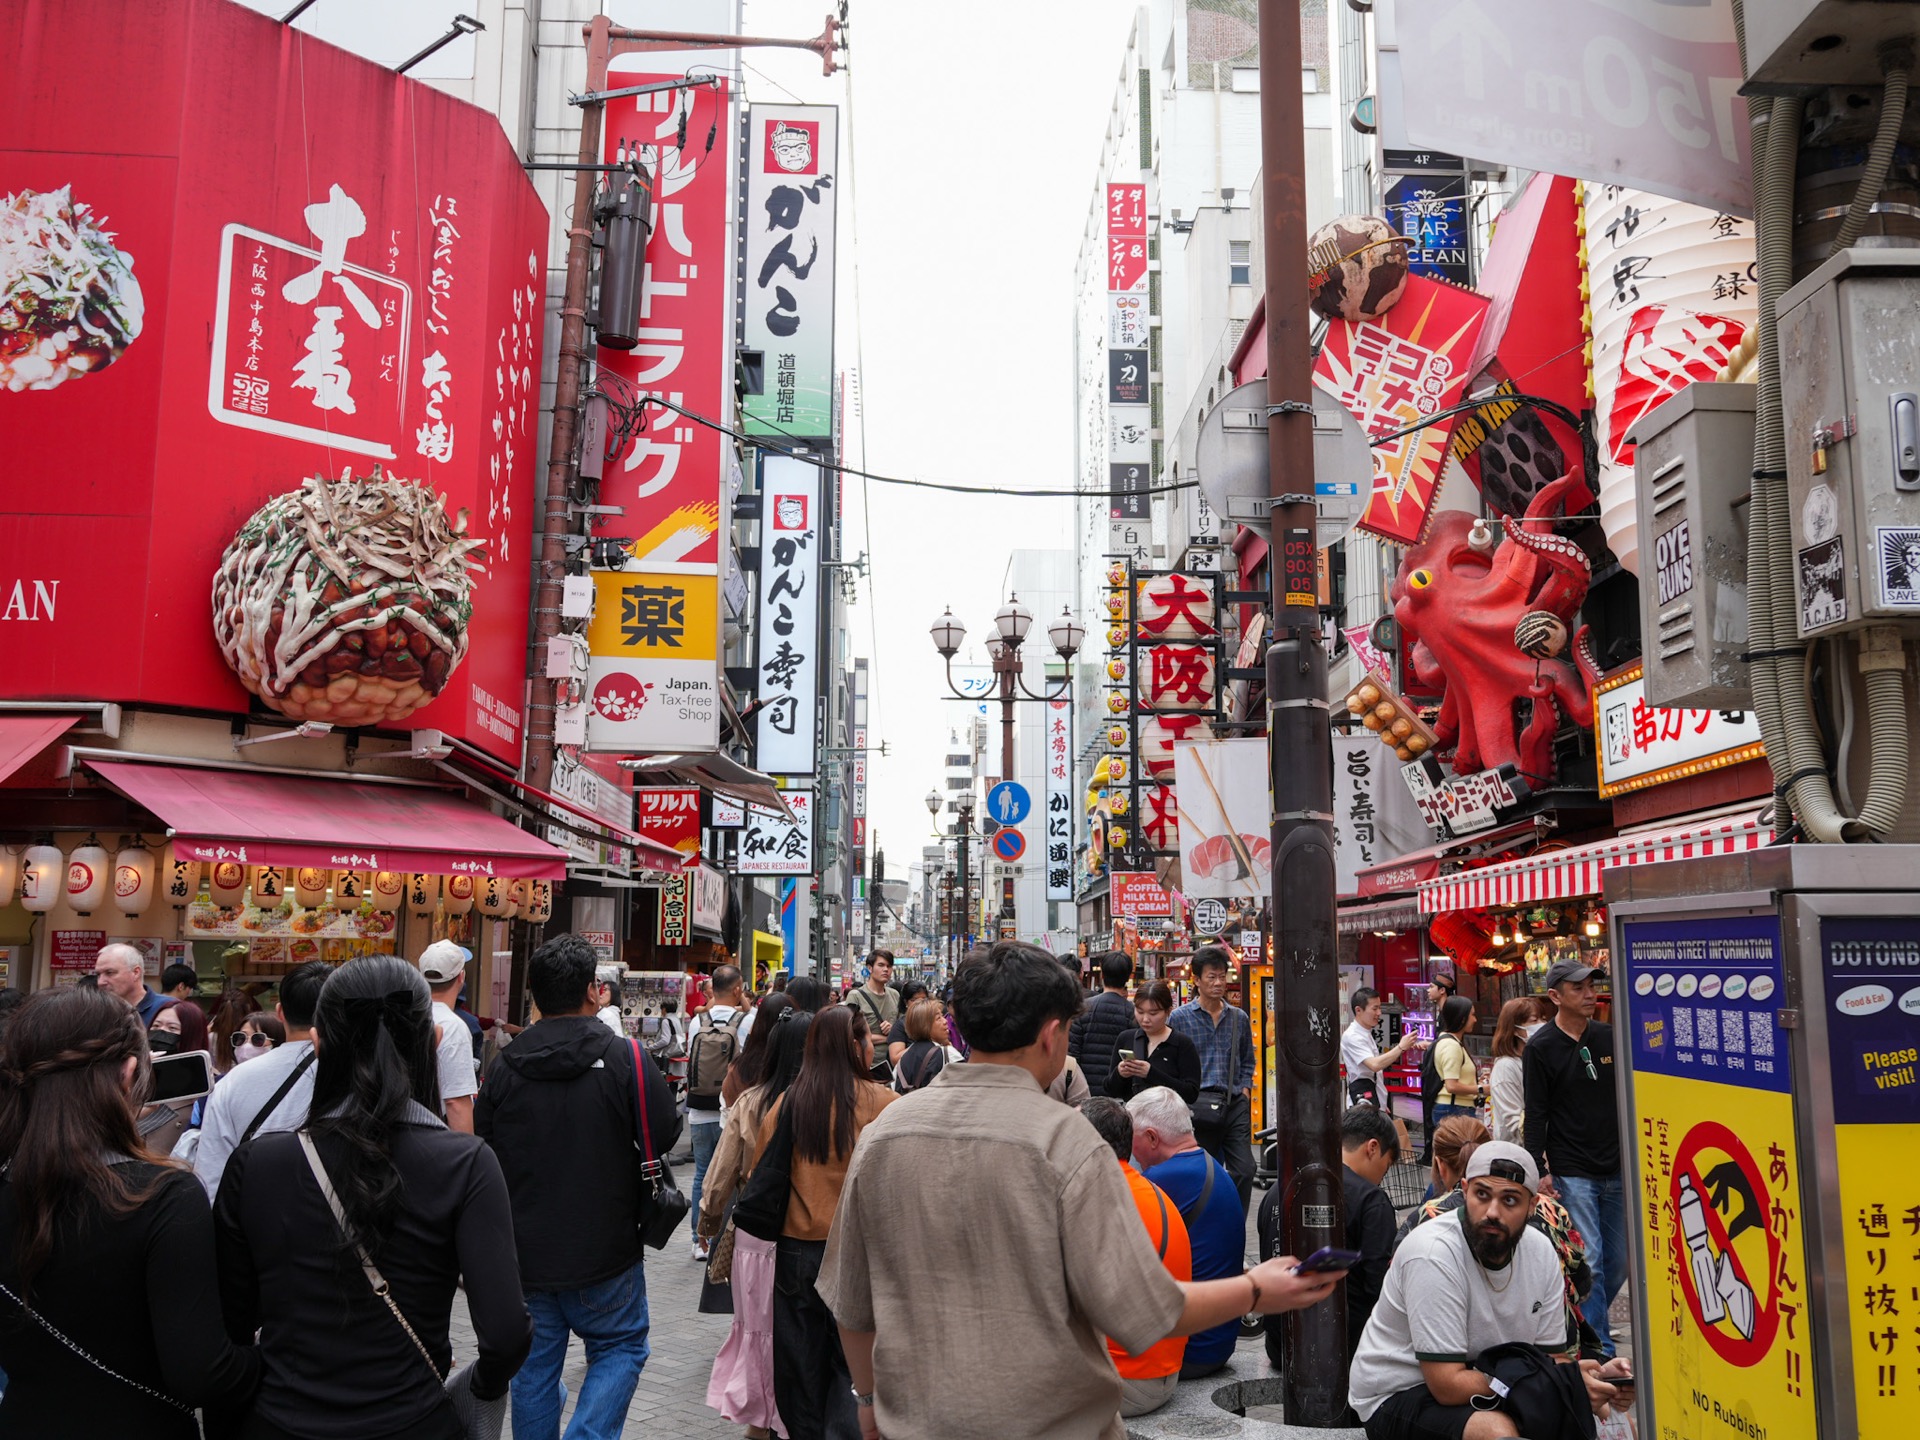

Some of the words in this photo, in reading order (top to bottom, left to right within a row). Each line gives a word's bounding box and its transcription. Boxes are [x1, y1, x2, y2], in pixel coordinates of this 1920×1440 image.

[1414, 156, 1430, 164] 4F
[1111, 189, 1125, 290] ダイニングバー
[1404, 221, 1449, 236] BAR
[387, 230, 401, 274] じゅう
[758, 174, 833, 337] がんこ
[1406, 250, 1466, 263] CEAN
[1708, 211, 1748, 300] 登録
[244, 245, 269, 371] 大阪西中島本店
[383, 298, 396, 327] はち
[379, 354, 393, 382] ばん
[776, 353, 796, 424] 道頓堀店
[1657, 521, 1690, 569] OYE
[1286, 559, 1313, 574] 903
[1291, 578, 1311, 591] 05
[1657, 555, 1693, 605] RUNS
[0, 579, 60, 621] AN
[1888, 590, 1918, 600] SAVE
[621, 585, 684, 647] 薬
[665, 677, 712, 691] Japan.
[963, 678, 992, 690] フジ
[660, 693, 712, 706] Tax-free
[679, 708, 711, 723] Shop
[1051, 717, 1067, 780] 本場の味
[642, 794, 698, 812] ツルハ
[642, 815, 687, 829] ドラッグ
[743, 827, 808, 859] 和食
[1049, 792, 1070, 888] かに道楽
[742, 862, 770, 870] JAPANESE
[772, 862, 808, 870] RESTAURANT
[995, 866, 1023, 875] 自動車
[1126, 884, 1163, 892] COFFEE
[1149, 893, 1167, 901] TEA
[1121, 903, 1136, 911] ICE
[1137, 903, 1169, 911] CREAM
[1242, 948, 1260, 957] 入口
[1632, 941, 1676, 960] DOTONBORI
[1677, 941, 1707, 960] STREET
[1709, 938, 1773, 960] INFORMATION
[1845, 997, 1865, 1008] Food
[1865, 996, 1871, 1005] &
[1644, 1020, 1664, 1034] Please
[1649, 1033, 1663, 1048] visit!
[1677, 1051, 1694, 1063] English
[1754, 1060, 1774, 1073] 日本語
[1863, 1047, 1918, 1071] Please
[1875, 1066, 1916, 1090] visit!
[1657, 1118, 1671, 1177] 空缶
[1663, 1198, 1683, 1337] ペットボトル
[1768, 1142, 1802, 1398] あかんで!!
[1858, 1203, 1900, 1397] 通り抜け!!
[1692, 1389, 1709, 1412] NO
[1714, 1400, 1767, 1440] Rubbish!
